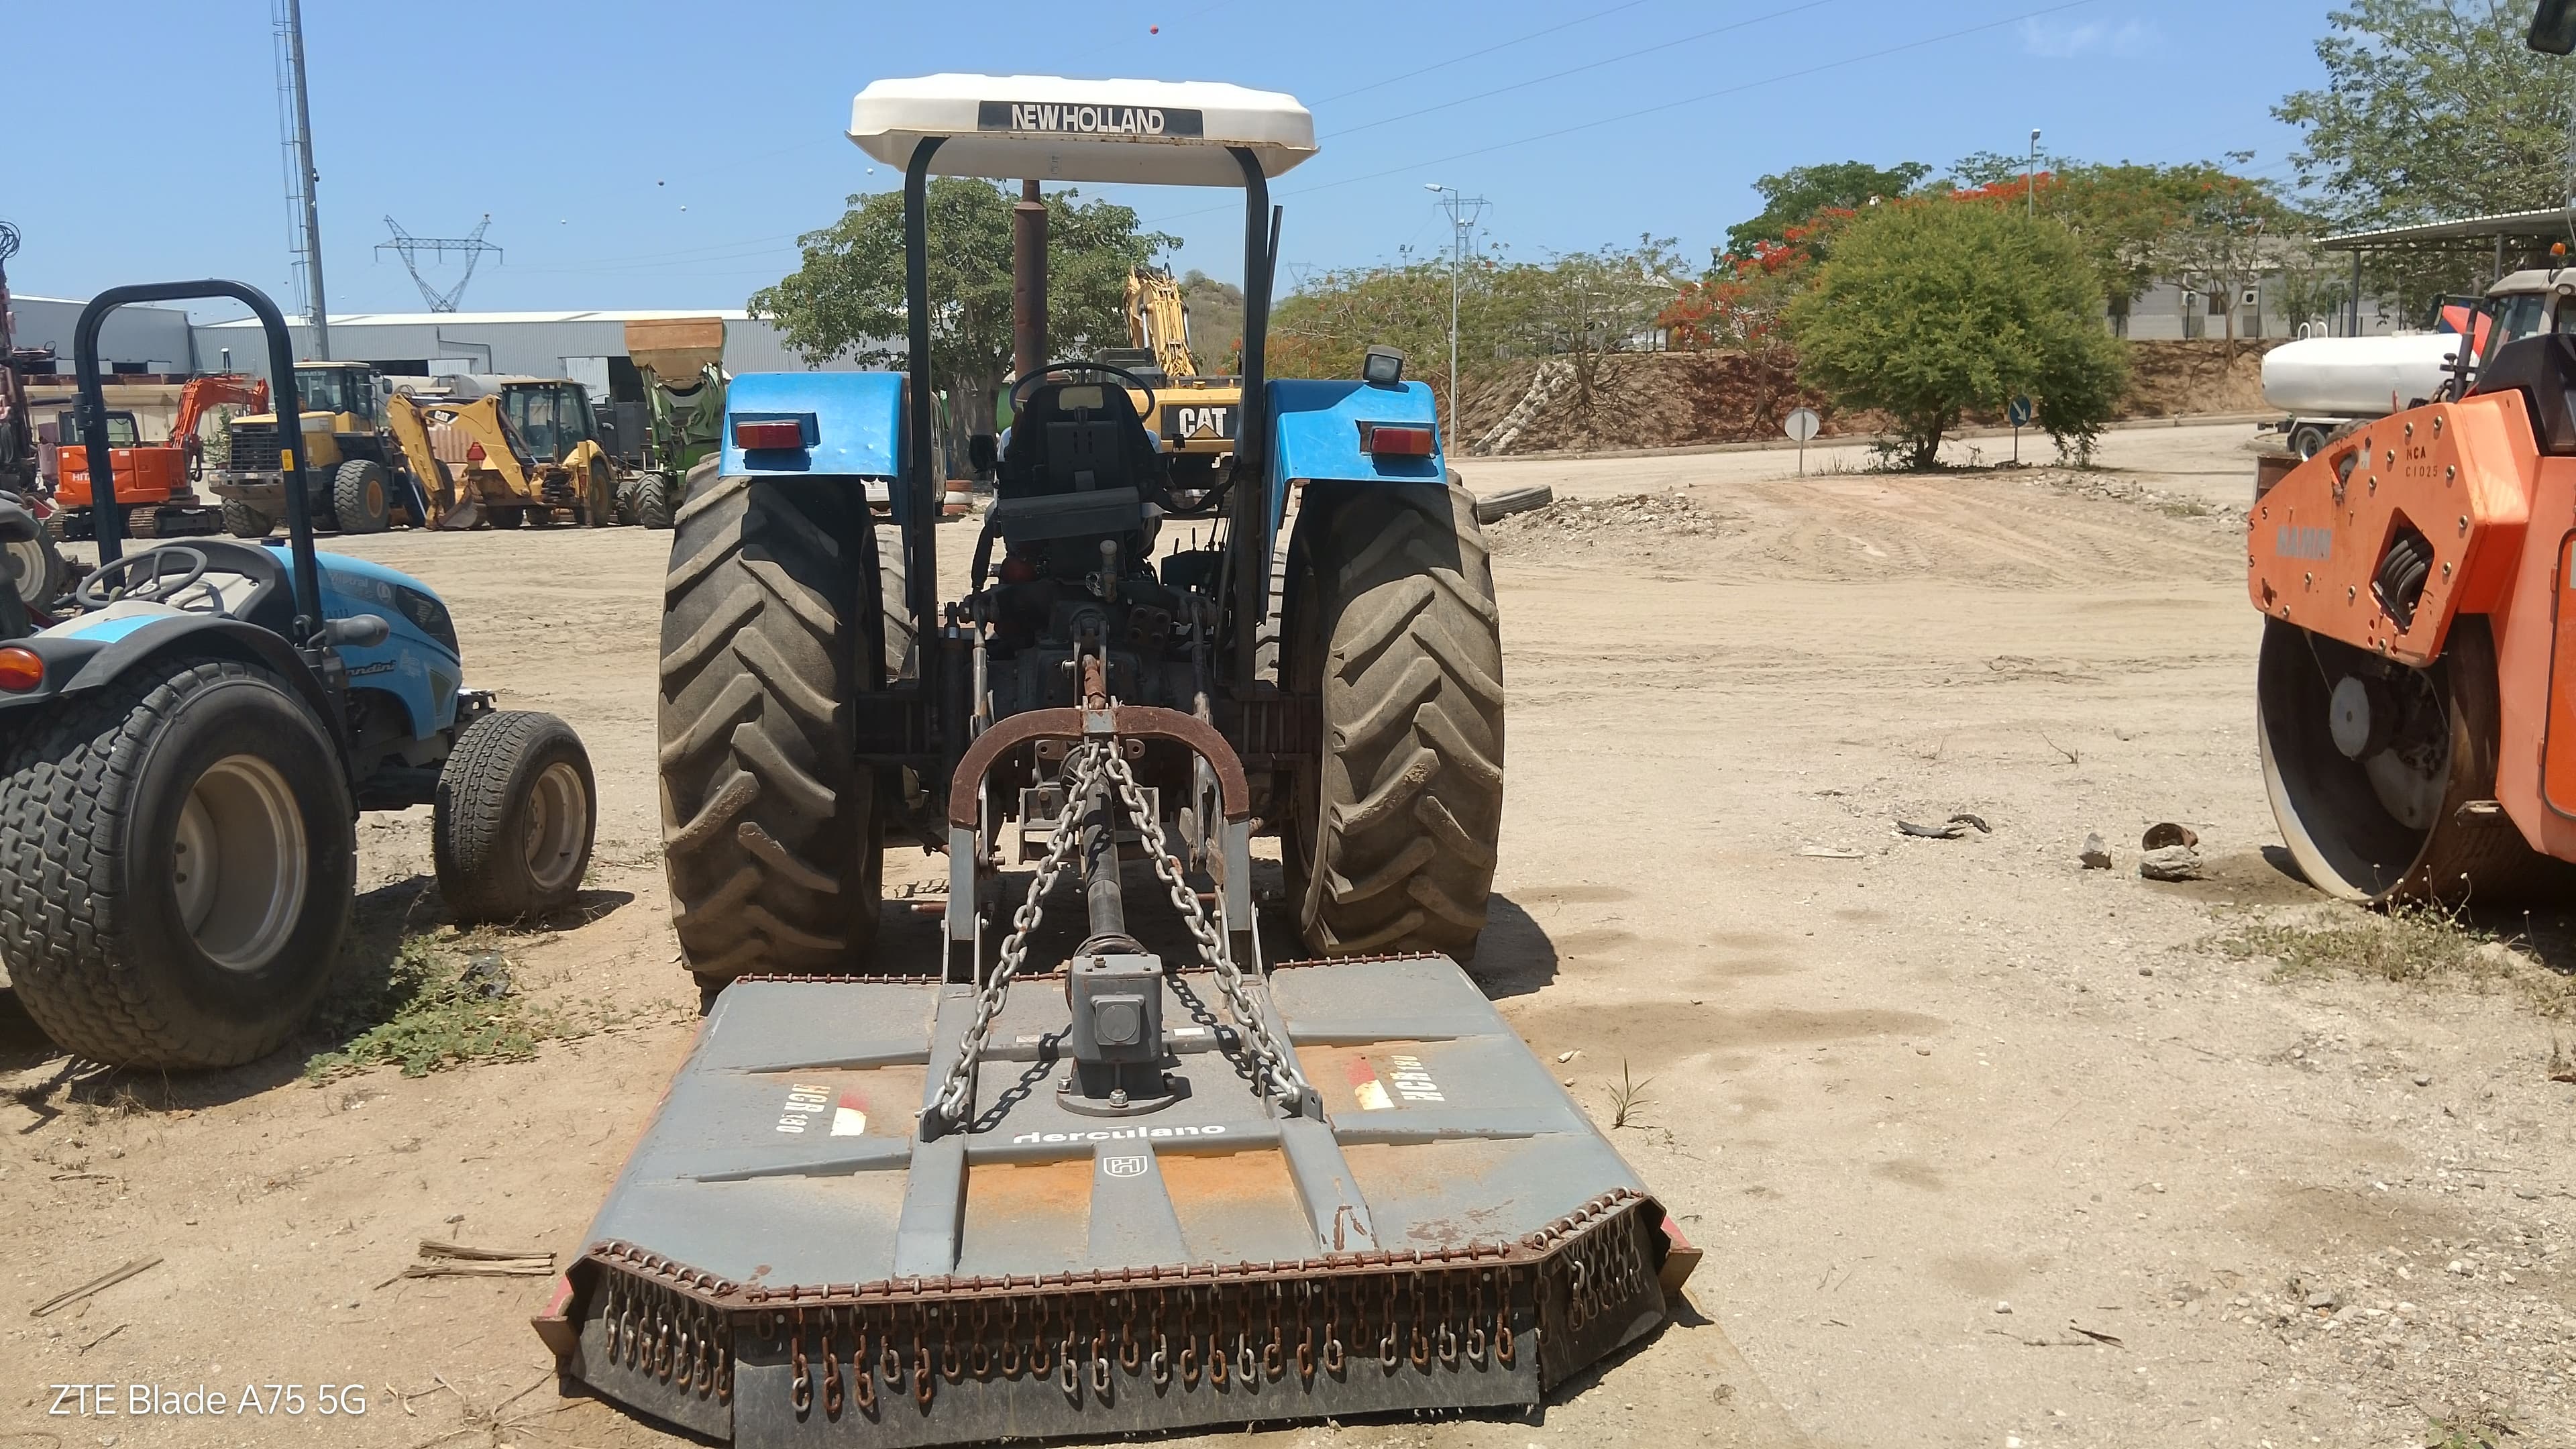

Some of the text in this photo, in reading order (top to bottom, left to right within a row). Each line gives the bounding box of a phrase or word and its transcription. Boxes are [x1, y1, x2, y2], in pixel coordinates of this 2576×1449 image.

[1012, 104, 1165, 135] NEW HOLLAND
[434, 410, 451, 422] CAT
[1179, 408, 1227, 438] CAT
